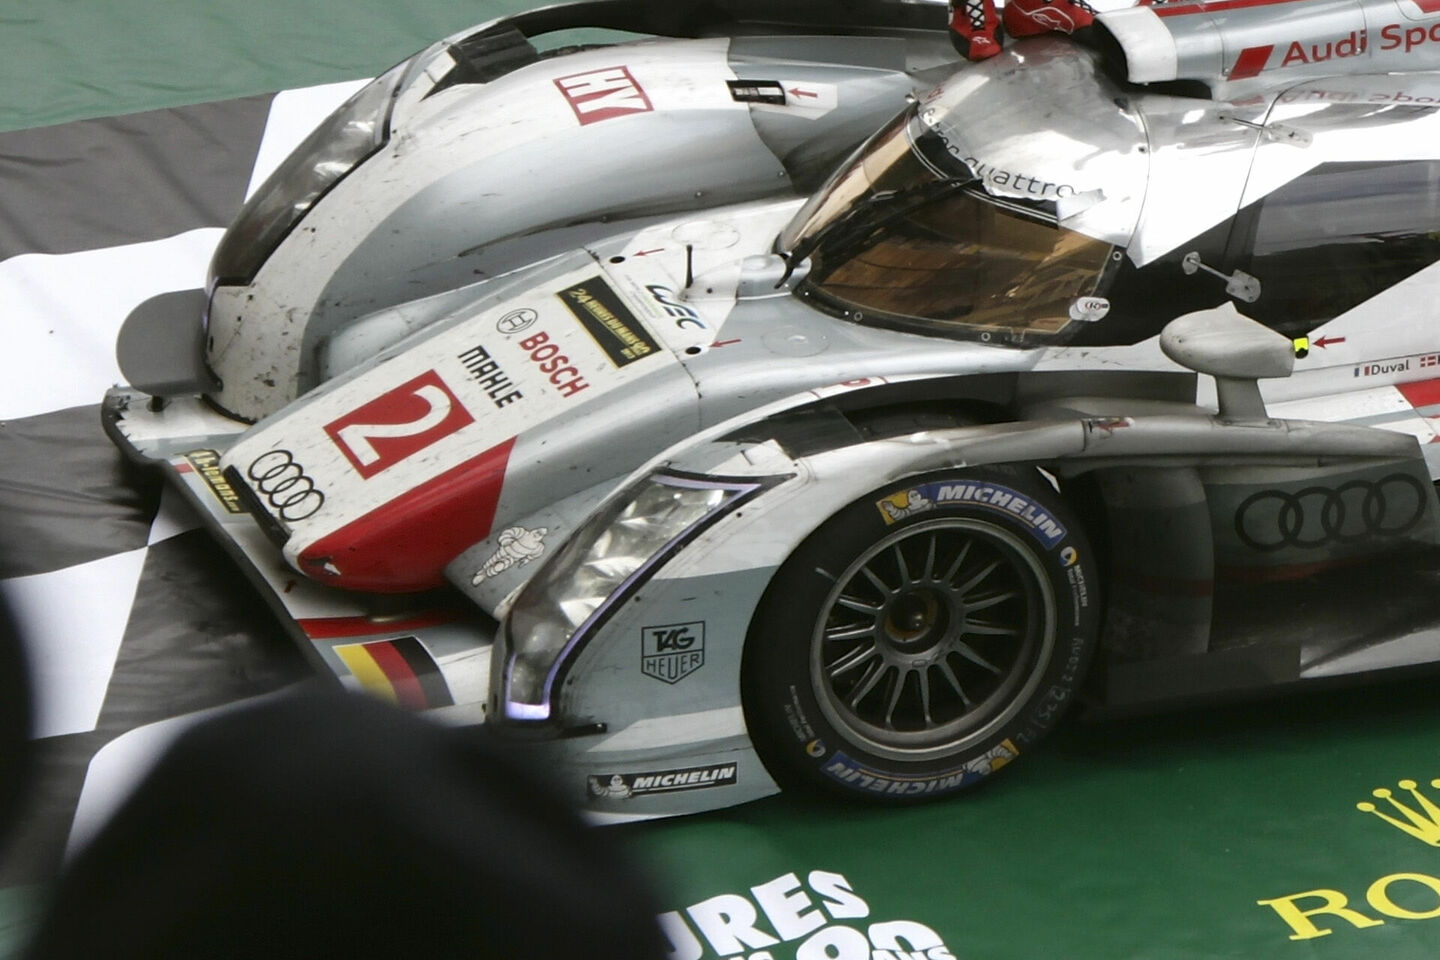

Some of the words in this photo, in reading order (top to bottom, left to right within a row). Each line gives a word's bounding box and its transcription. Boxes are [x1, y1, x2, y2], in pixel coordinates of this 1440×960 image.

[1280, 29, 1368, 68] Audi
[645, 284, 707, 331] WEC
[456, 344, 524, 410] MAHLE
[518, 330, 591, 400] BOSCH
[1371, 359, 1410, 377] Duval
[337, 384, 453, 468] 2
[936, 484, 1064, 540] MICHELIN
[652, 627, 696, 652] TAG
[646, 652, 701, 681] HEUER
[632, 765, 736, 790] MICHELIN
[825, 761, 965, 796] MICHELIN
[655, 869, 871, 958] URES
